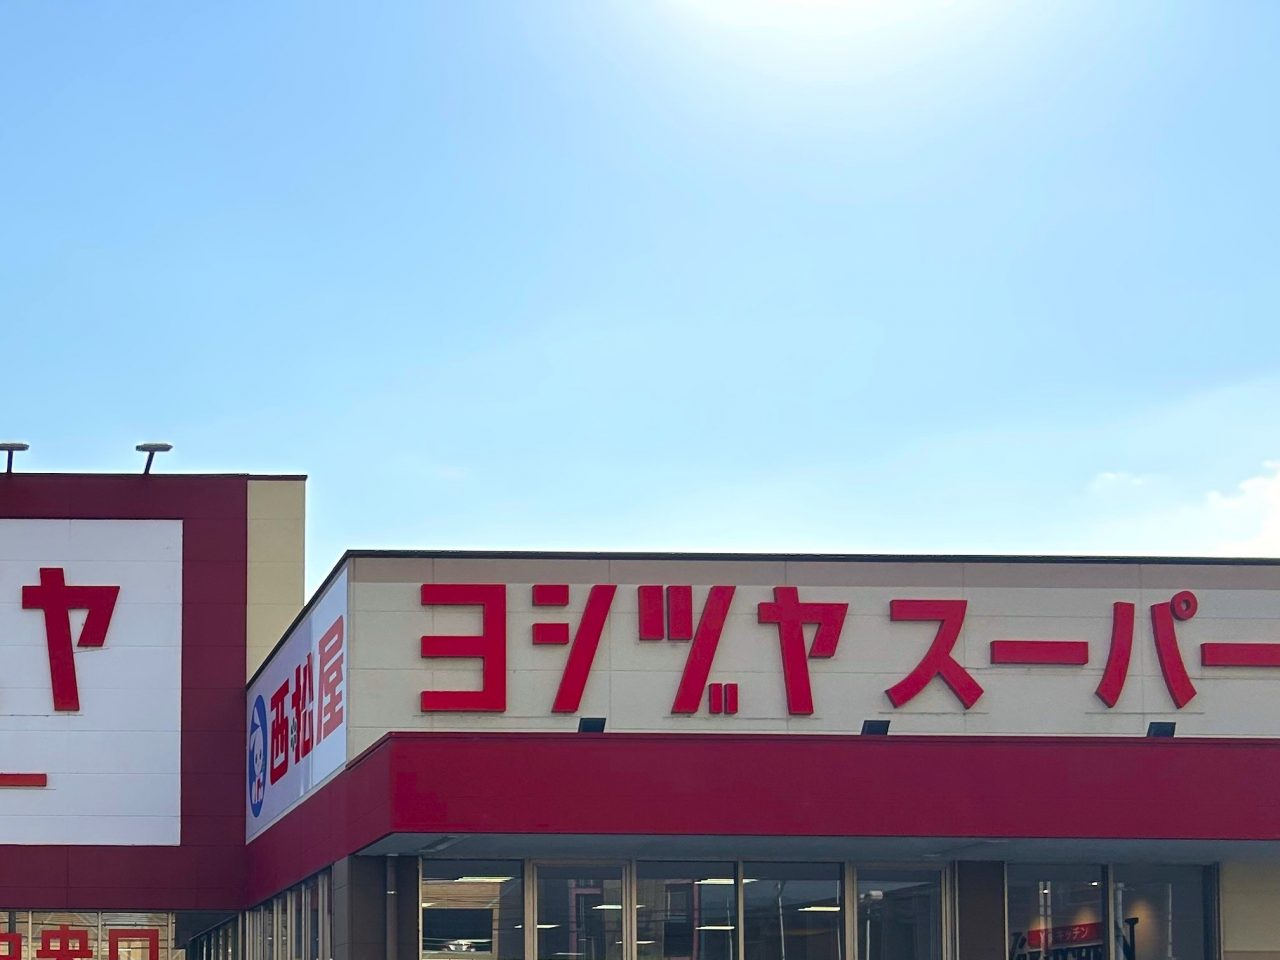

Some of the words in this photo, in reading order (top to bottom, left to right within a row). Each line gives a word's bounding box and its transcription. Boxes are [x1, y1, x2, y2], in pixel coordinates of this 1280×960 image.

[269, 614, 344, 786] 西松屋
[420, 584, 1280, 716] ヨシヅヤスーパー
